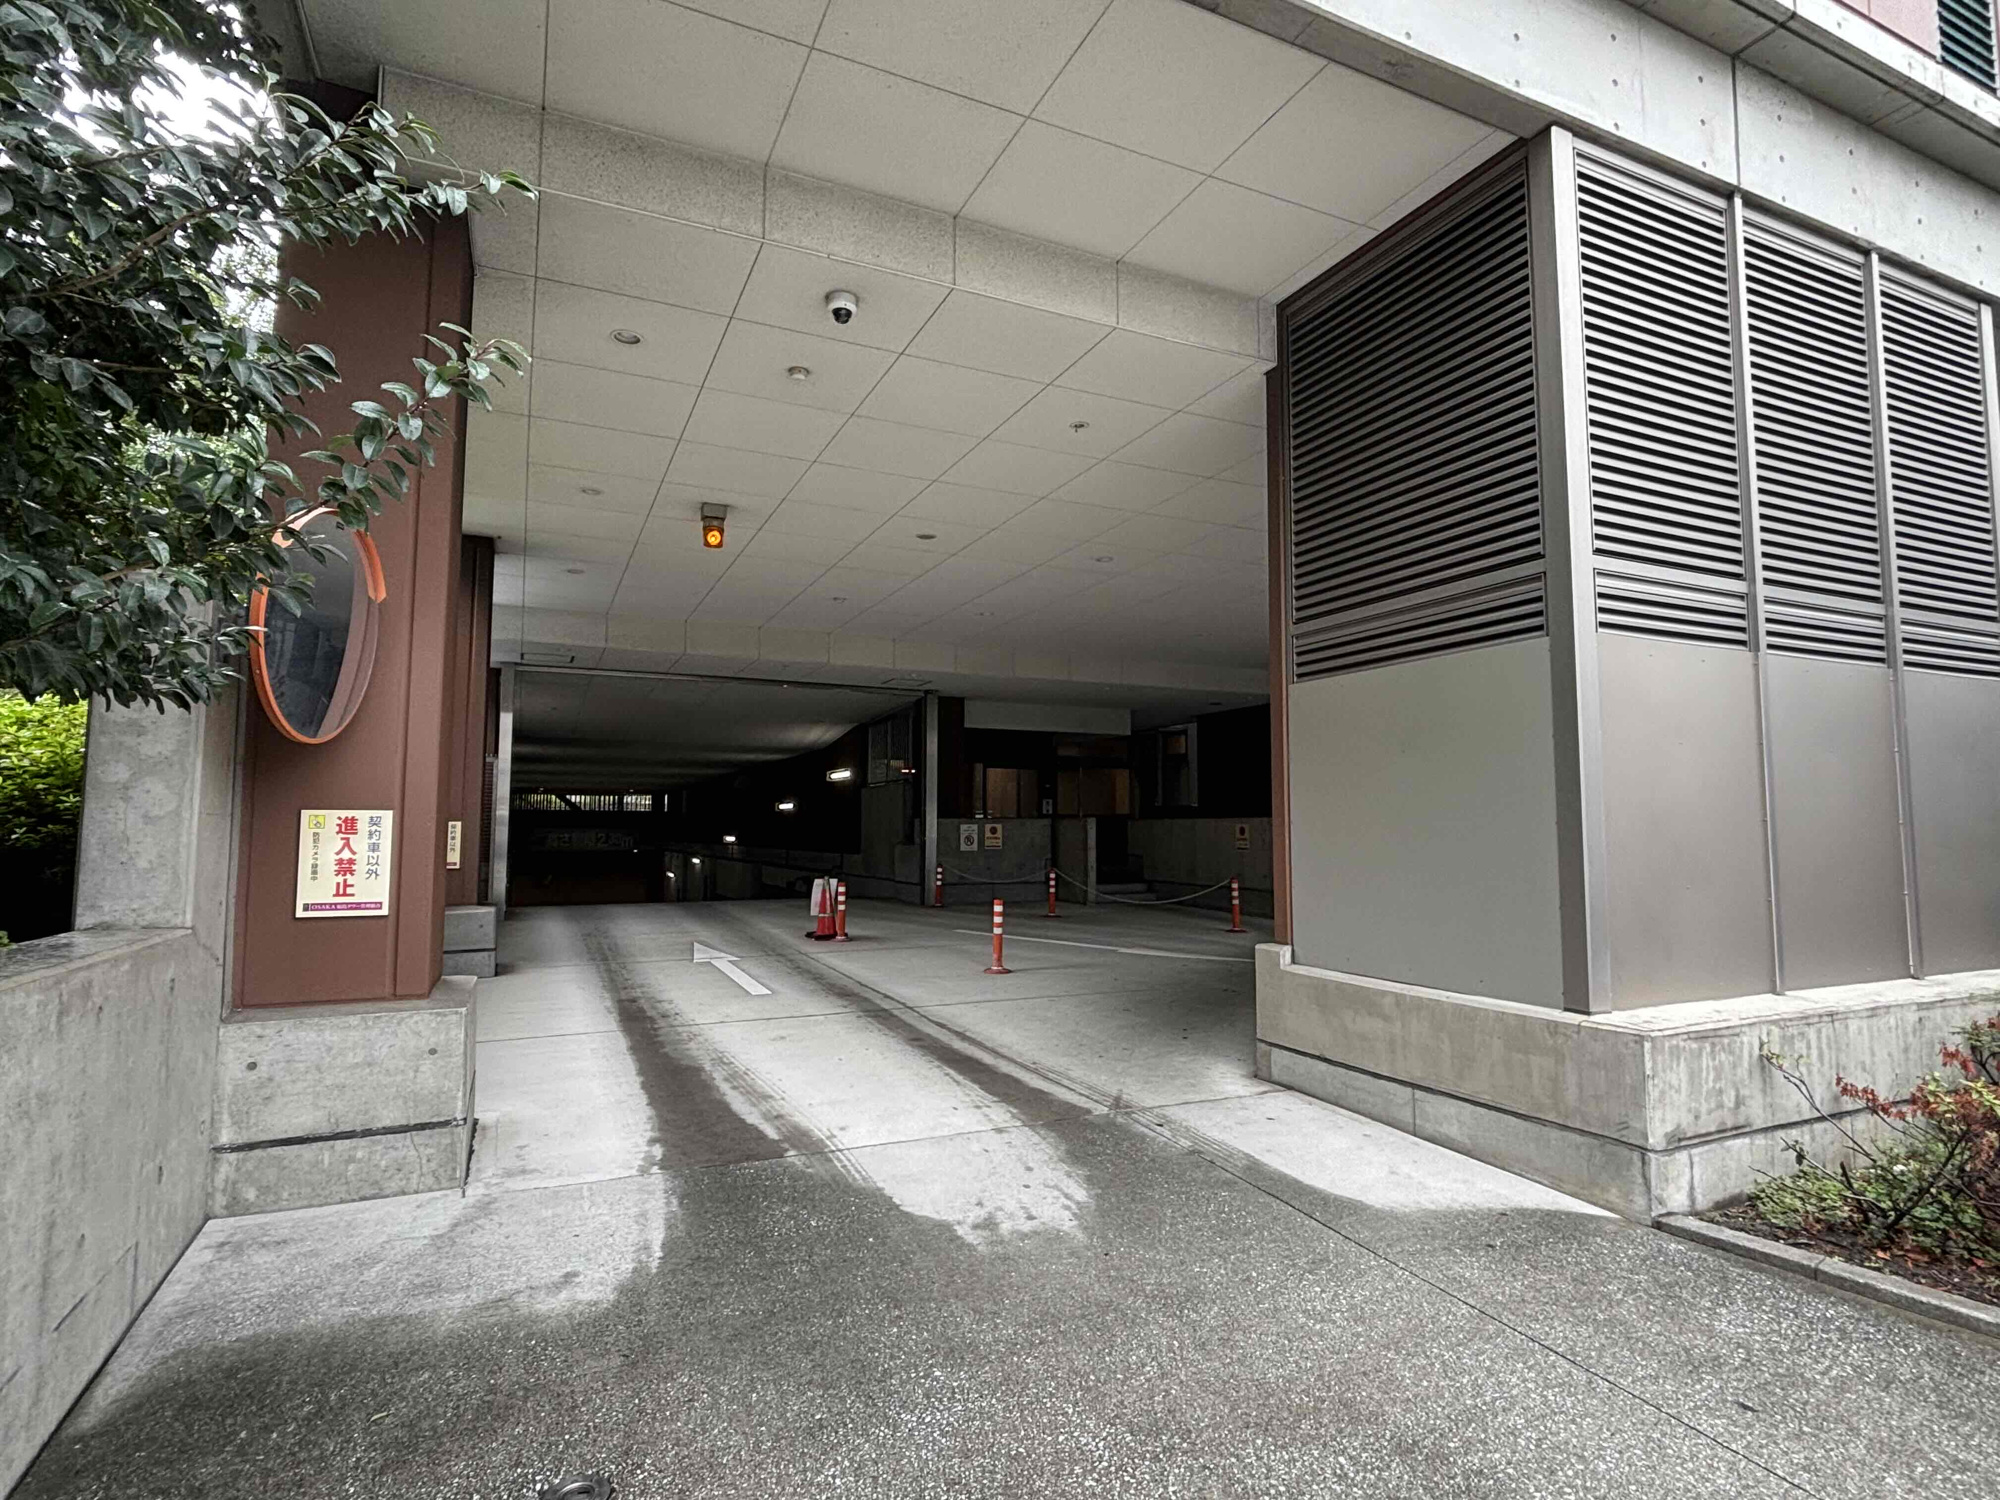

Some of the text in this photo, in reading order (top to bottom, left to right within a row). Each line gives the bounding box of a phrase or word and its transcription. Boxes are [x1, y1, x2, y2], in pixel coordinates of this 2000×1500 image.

[333, 816, 358, 897] 進入禁止
[365, 816, 382, 881] 契約車以外
